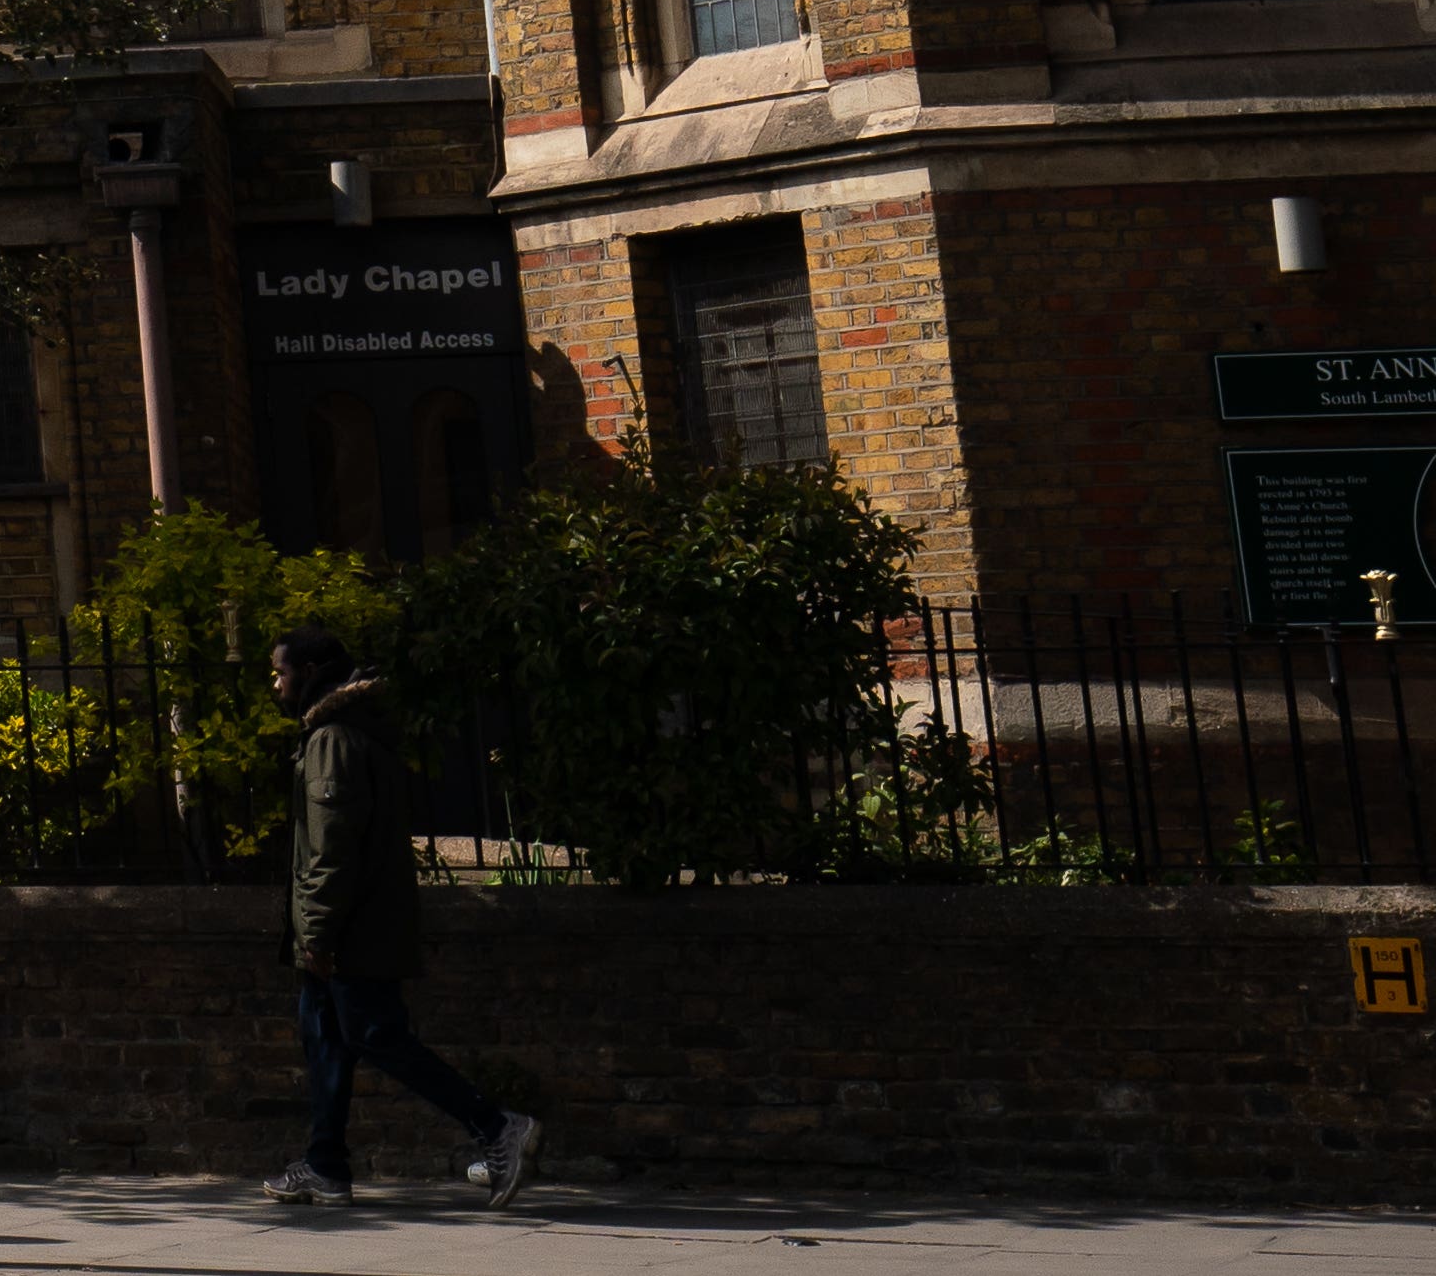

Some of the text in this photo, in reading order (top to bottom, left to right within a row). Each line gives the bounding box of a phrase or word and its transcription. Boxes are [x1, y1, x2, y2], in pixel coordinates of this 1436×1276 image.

[257, 261, 502, 298] Lady Chapel
[274, 330, 494, 354] Hall Disabled Access
[1316, 359, 1361, 382] ST.
[1320, 391, 1367, 406] South
[1255, 475, 1368, 487] This building was first
[1258, 489, 1293, 499] erected
[1295, 489, 1306, 498] in
[1334, 489, 1347, 498] as
[1262, 514, 1354, 524] Rebuilt after bomb
[1264, 528, 1300, 538] damage
[1325, 528, 1345, 536] now
[1265, 540, 1345, 550] divided into two
[1267, 553, 1289, 562] with
[1299, 553, 1318, 562] hall
[1269, 566, 1333, 575] stairs and the
[1271, 592, 1288, 600] te
[1290, 591, 1310, 600] first
[1375, 950, 1399, 961] 150
[1360, 946, 1418, 1005] H
[1388, 990, 1397, 1001] 3
